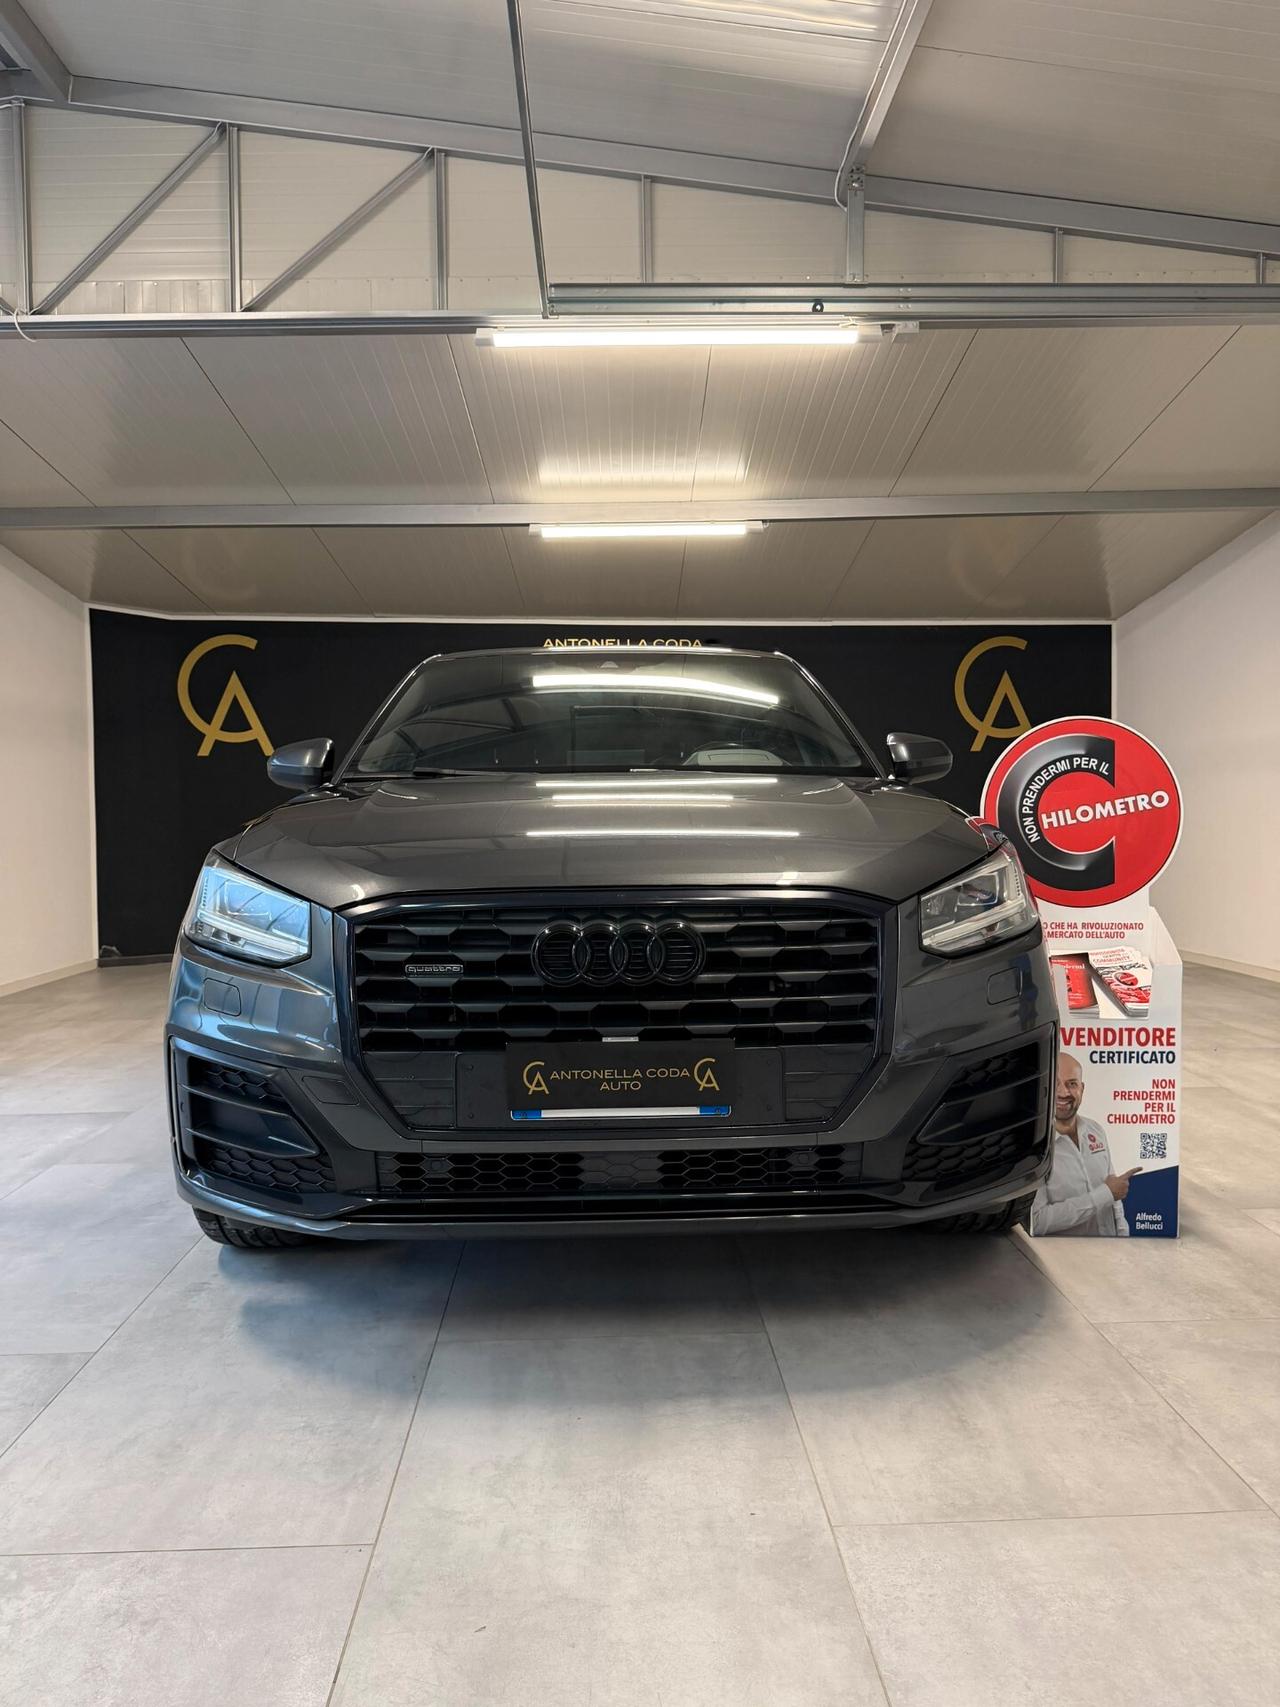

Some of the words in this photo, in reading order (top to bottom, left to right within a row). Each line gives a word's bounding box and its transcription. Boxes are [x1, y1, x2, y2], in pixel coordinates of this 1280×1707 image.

[543, 638, 647, 648] ANTONELLA
[653, 638, 703, 648] CODA
[1073, 756, 1098, 769] PER
[1099, 761, 1110, 776] IL
[1022, 758, 1071, 814] PRENDERMI
[1023, 817, 1041, 844] NON
[1050, 922, 1065, 930] CHE
[1067, 922, 1078, 930] HA
[1081, 922, 1144, 931] RIVOLUZIONATO
[1047, 931, 1084, 939] MERCATO
[1085, 931, 1126, 939] DELL'AUTO
[408, 964, 461, 973] quattro
[1060, 1027, 1176, 1047] VENDITORE
[1089, 1050, 1176, 1064] CERTIFICATO
[550, 1068, 643, 1080] ANTONELLA
[646, 1067, 691, 1078] CODA
[600, 1081, 642, 1091] AUTO
[1152, 1079, 1176, 1089] NON
[1113, 1090, 1176, 1101] PRENDERMI
[1144, 1102, 1164, 1112] PER
[1167, 1102, 1176, 1112] IL
[1107, 1113, 1176, 1125] CHILOMETRO
[1135, 1212, 1162, 1221] Alfredo
[1135, 1221, 1163, 1230] Bellucci
